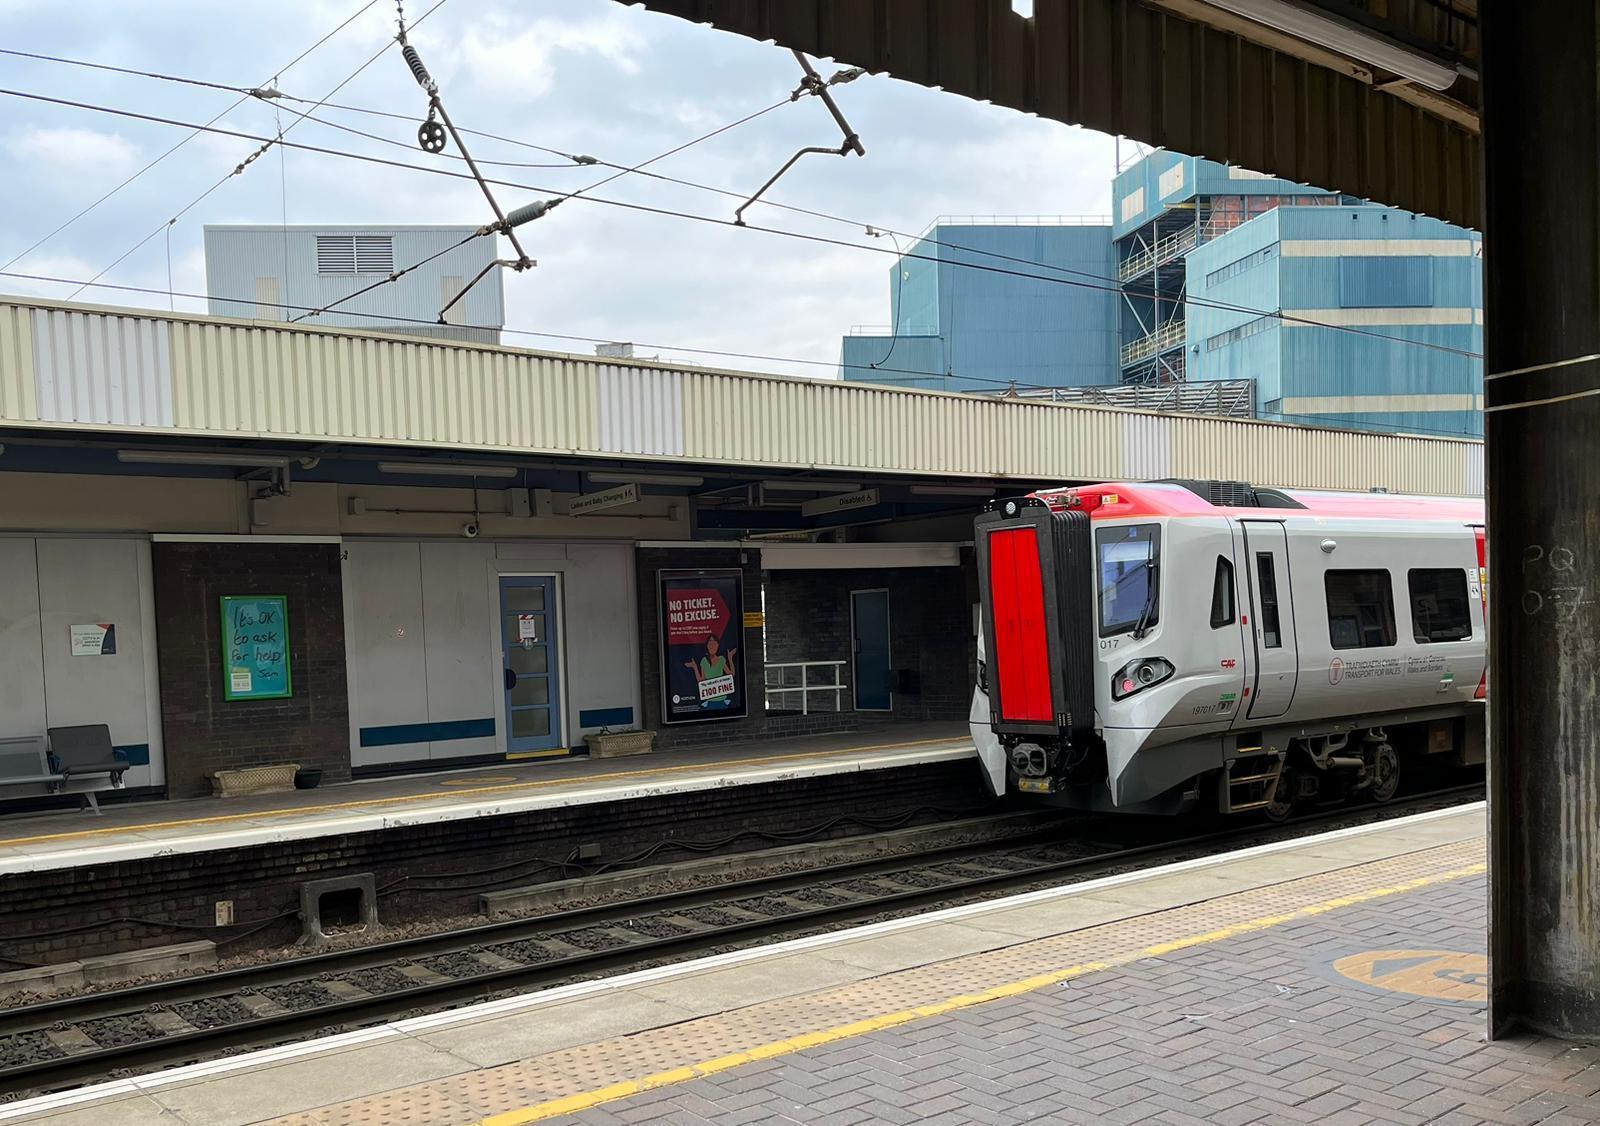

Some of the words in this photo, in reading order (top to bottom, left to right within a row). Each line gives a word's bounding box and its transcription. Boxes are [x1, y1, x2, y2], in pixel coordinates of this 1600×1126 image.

[584, 498, 592, 506] and
[839, 495, 865, 506] Disabled
[669, 600, 682, 611] NO
[683, 597, 715, 610] TICKET.
[258, 611, 275, 625] OK
[670, 611, 684, 623] NO
[684, 608, 720, 622] EXCUSE.
[233, 629, 249, 646] to
[252, 631, 278, 643] ask
[1100, 639, 1119, 649] 017
[231, 648, 249, 662] for
[1220, 659, 1236, 669] CAF
[257, 669, 279, 679] Sam
[1345, 670, 1374, 680] TRANSPORT
[1375, 668, 1385, 677] FOR
[701, 686, 717, 698] £100
[718, 682, 733, 694] FINE
[1192, 703, 1216, 716] 197017
